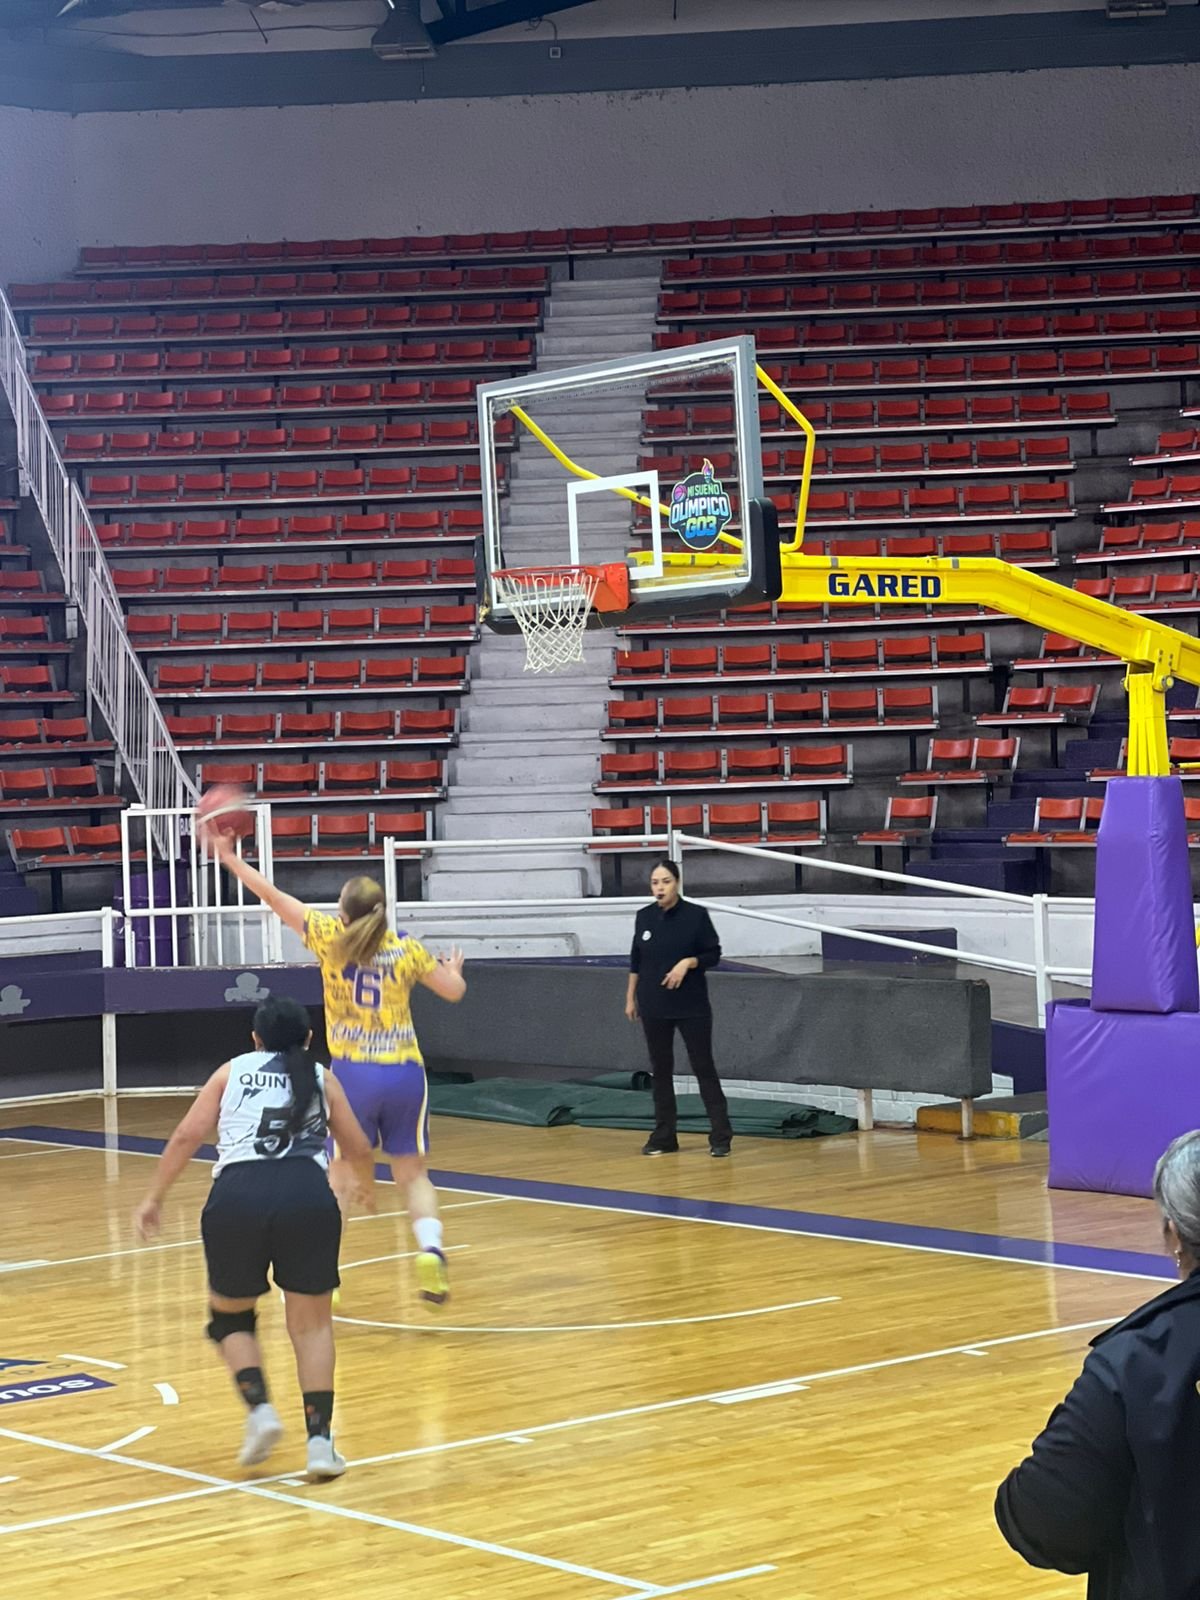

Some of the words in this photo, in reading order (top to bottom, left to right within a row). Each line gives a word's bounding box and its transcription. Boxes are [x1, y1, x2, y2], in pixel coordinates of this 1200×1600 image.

[671, 497, 729, 524] OLÍMPICO
[828, 573, 941, 598] GARED
[354, 966, 382, 1010] 6
[253, 1106, 294, 1156] 5
